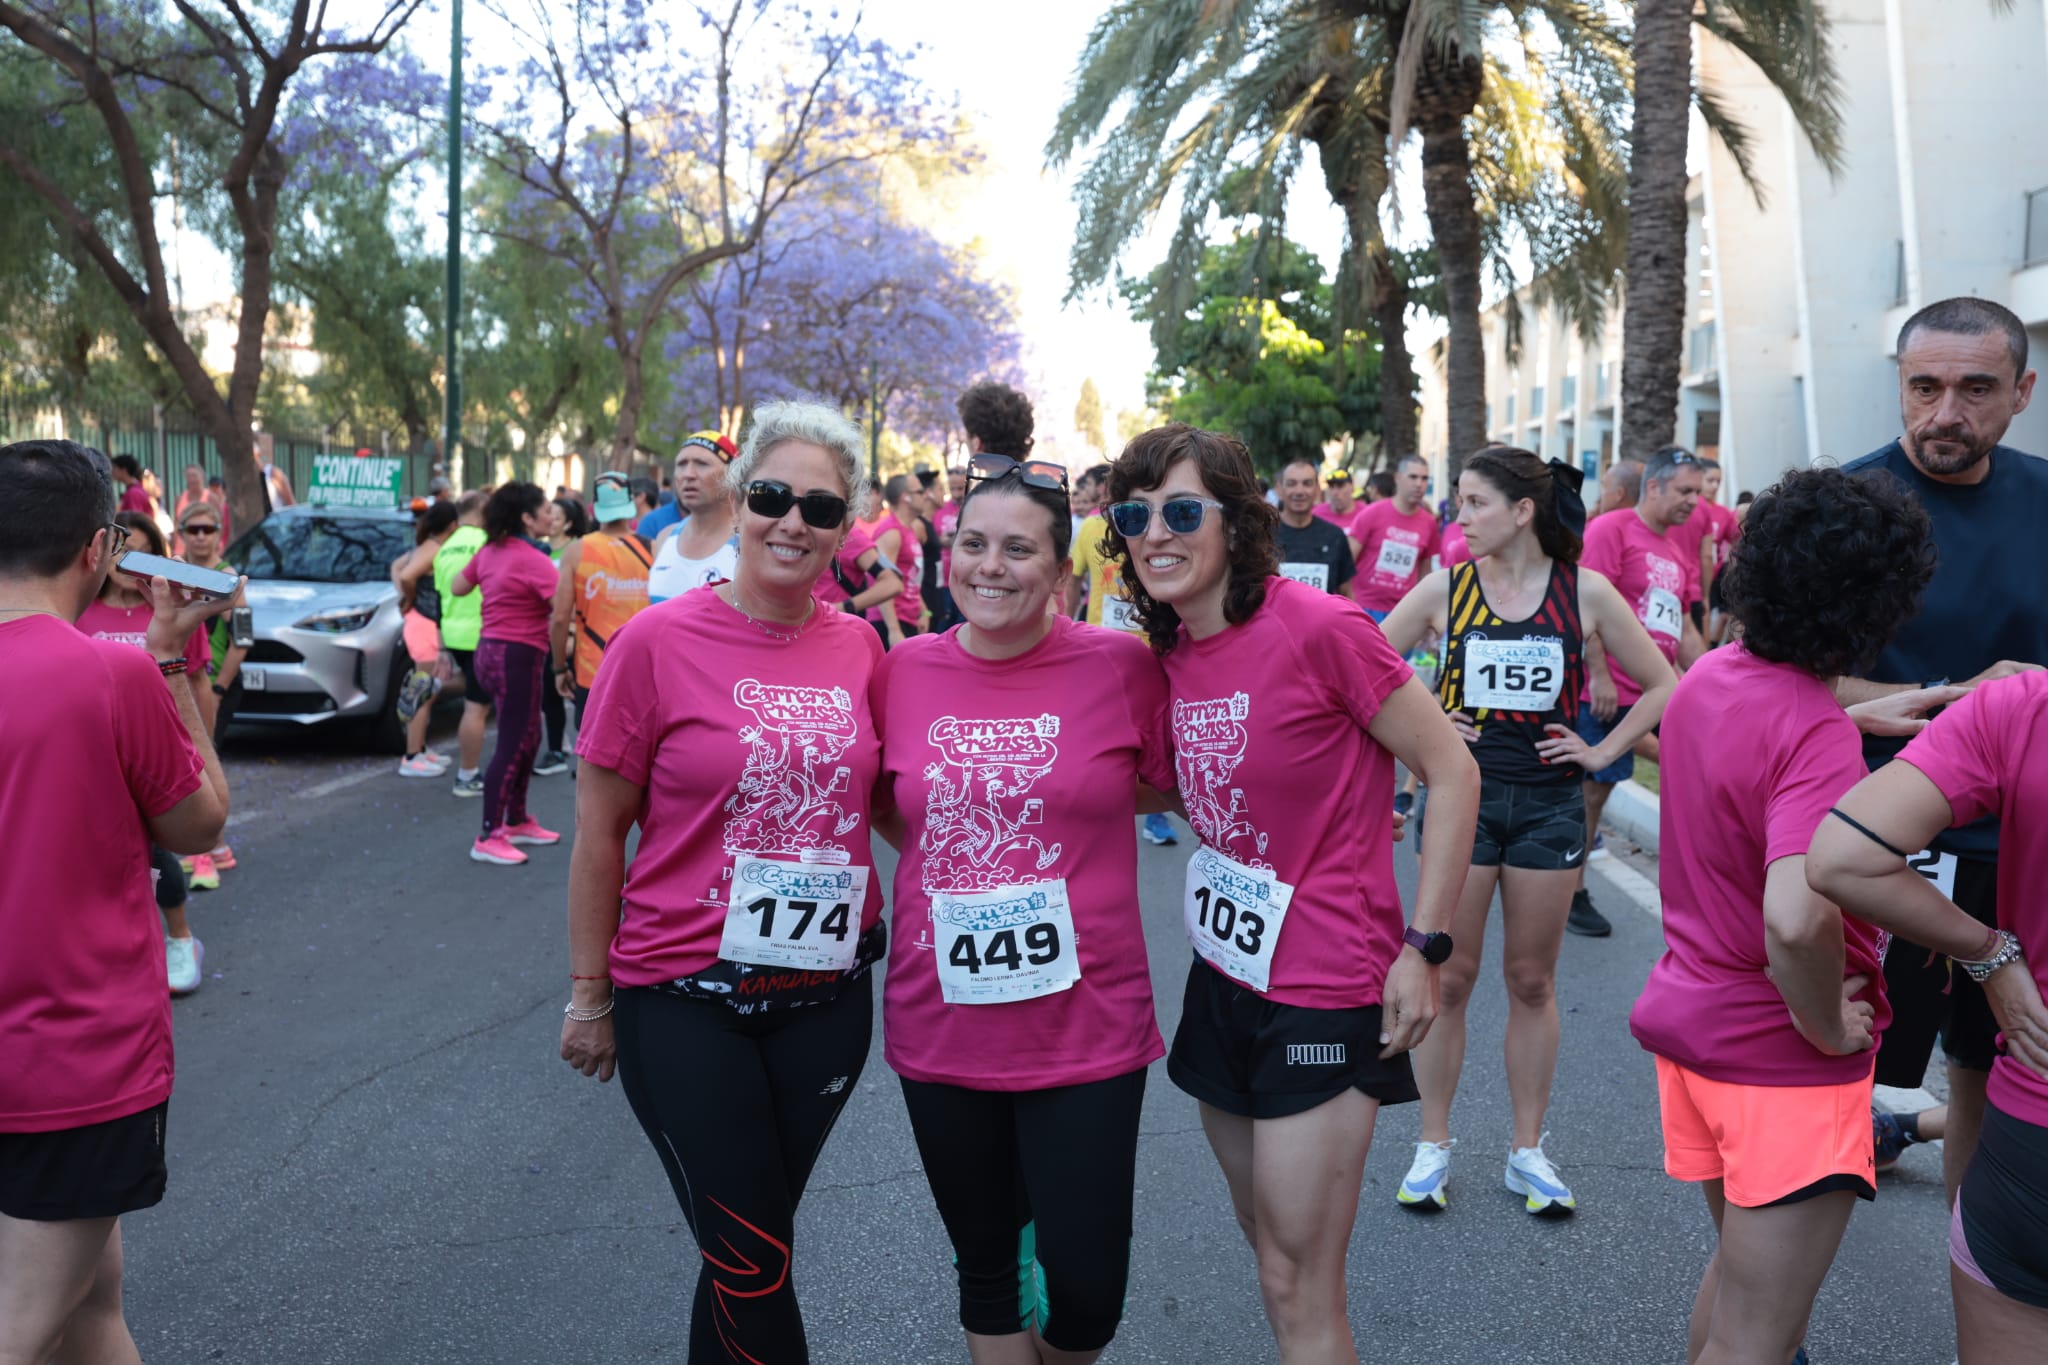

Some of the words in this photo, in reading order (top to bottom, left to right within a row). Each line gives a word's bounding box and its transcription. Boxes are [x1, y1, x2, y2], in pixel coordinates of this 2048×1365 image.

[314, 456, 401, 488] "CONTINUE"
[1478, 664, 1552, 692] 152
[743, 685, 834, 706] Carrera
[762, 703, 843, 722] Prensa
[1175, 700, 1231, 725] Carrera
[1232, 695, 1246, 706] de
[935, 720, 1036, 738] Carrera
[1038, 716, 1056, 725] de
[1179, 719, 1236, 740] Prensa
[951, 735, 1043, 754] Prensa
[763, 867, 838, 888] Carrera
[1205, 856, 1258, 894] Carrera
[776, 882, 841, 900] Prensa
[1211, 876, 1258, 909] Prensa
[747, 897, 850, 942] 174
[951, 898, 1030, 920] Carrera
[965, 911, 1039, 931] Prensa
[1194, 886, 1265, 956] 103
[949, 922, 1060, 974] 449
[1287, 1044, 1346, 1065] PUMA
